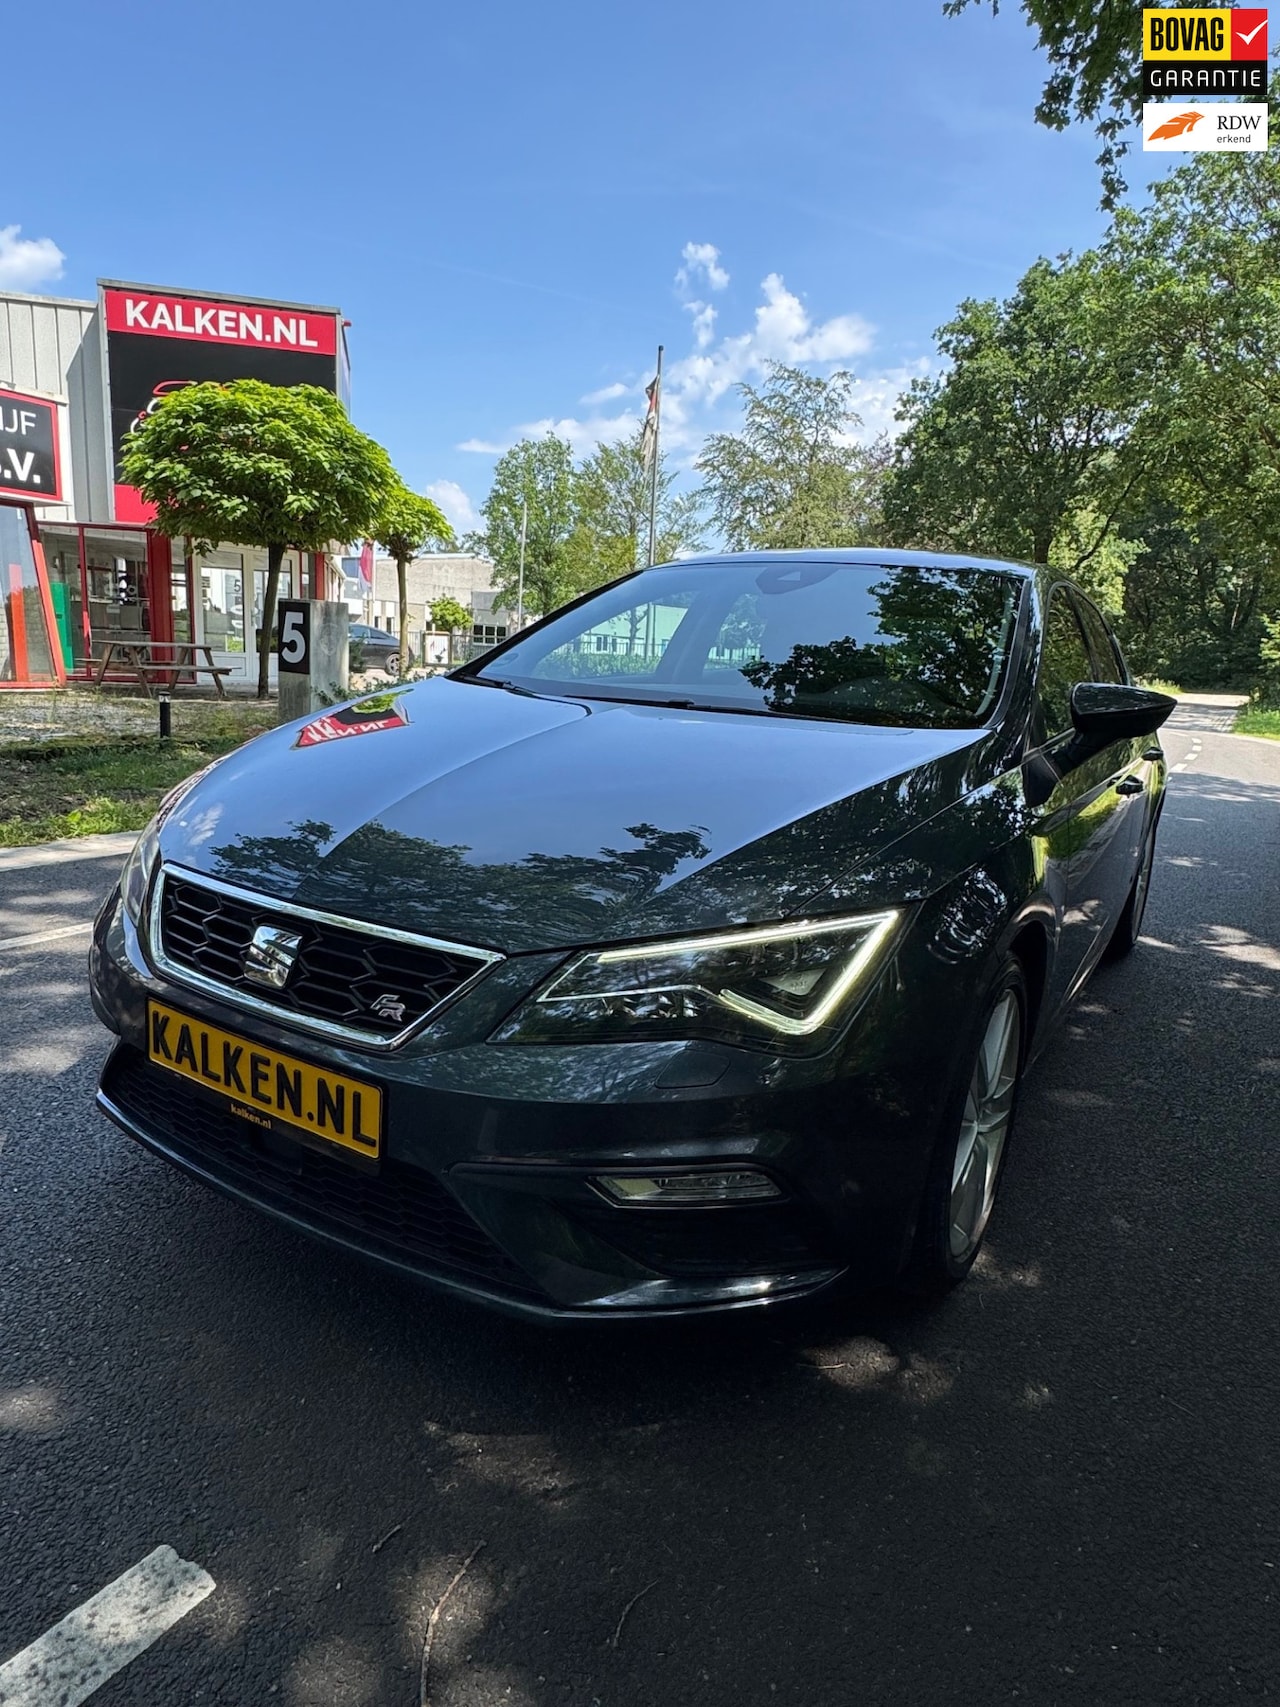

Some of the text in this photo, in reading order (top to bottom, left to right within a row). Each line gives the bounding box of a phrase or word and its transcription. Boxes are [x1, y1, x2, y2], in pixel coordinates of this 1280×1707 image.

[125, 299, 318, 347] KALKEN.NL
[0, 447, 41, 484] .V.
[281, 610, 306, 664] 5
[152, 1011, 377, 1147] KALKEN.NL
[230, 1103, 272, 1130] kalken.nl
